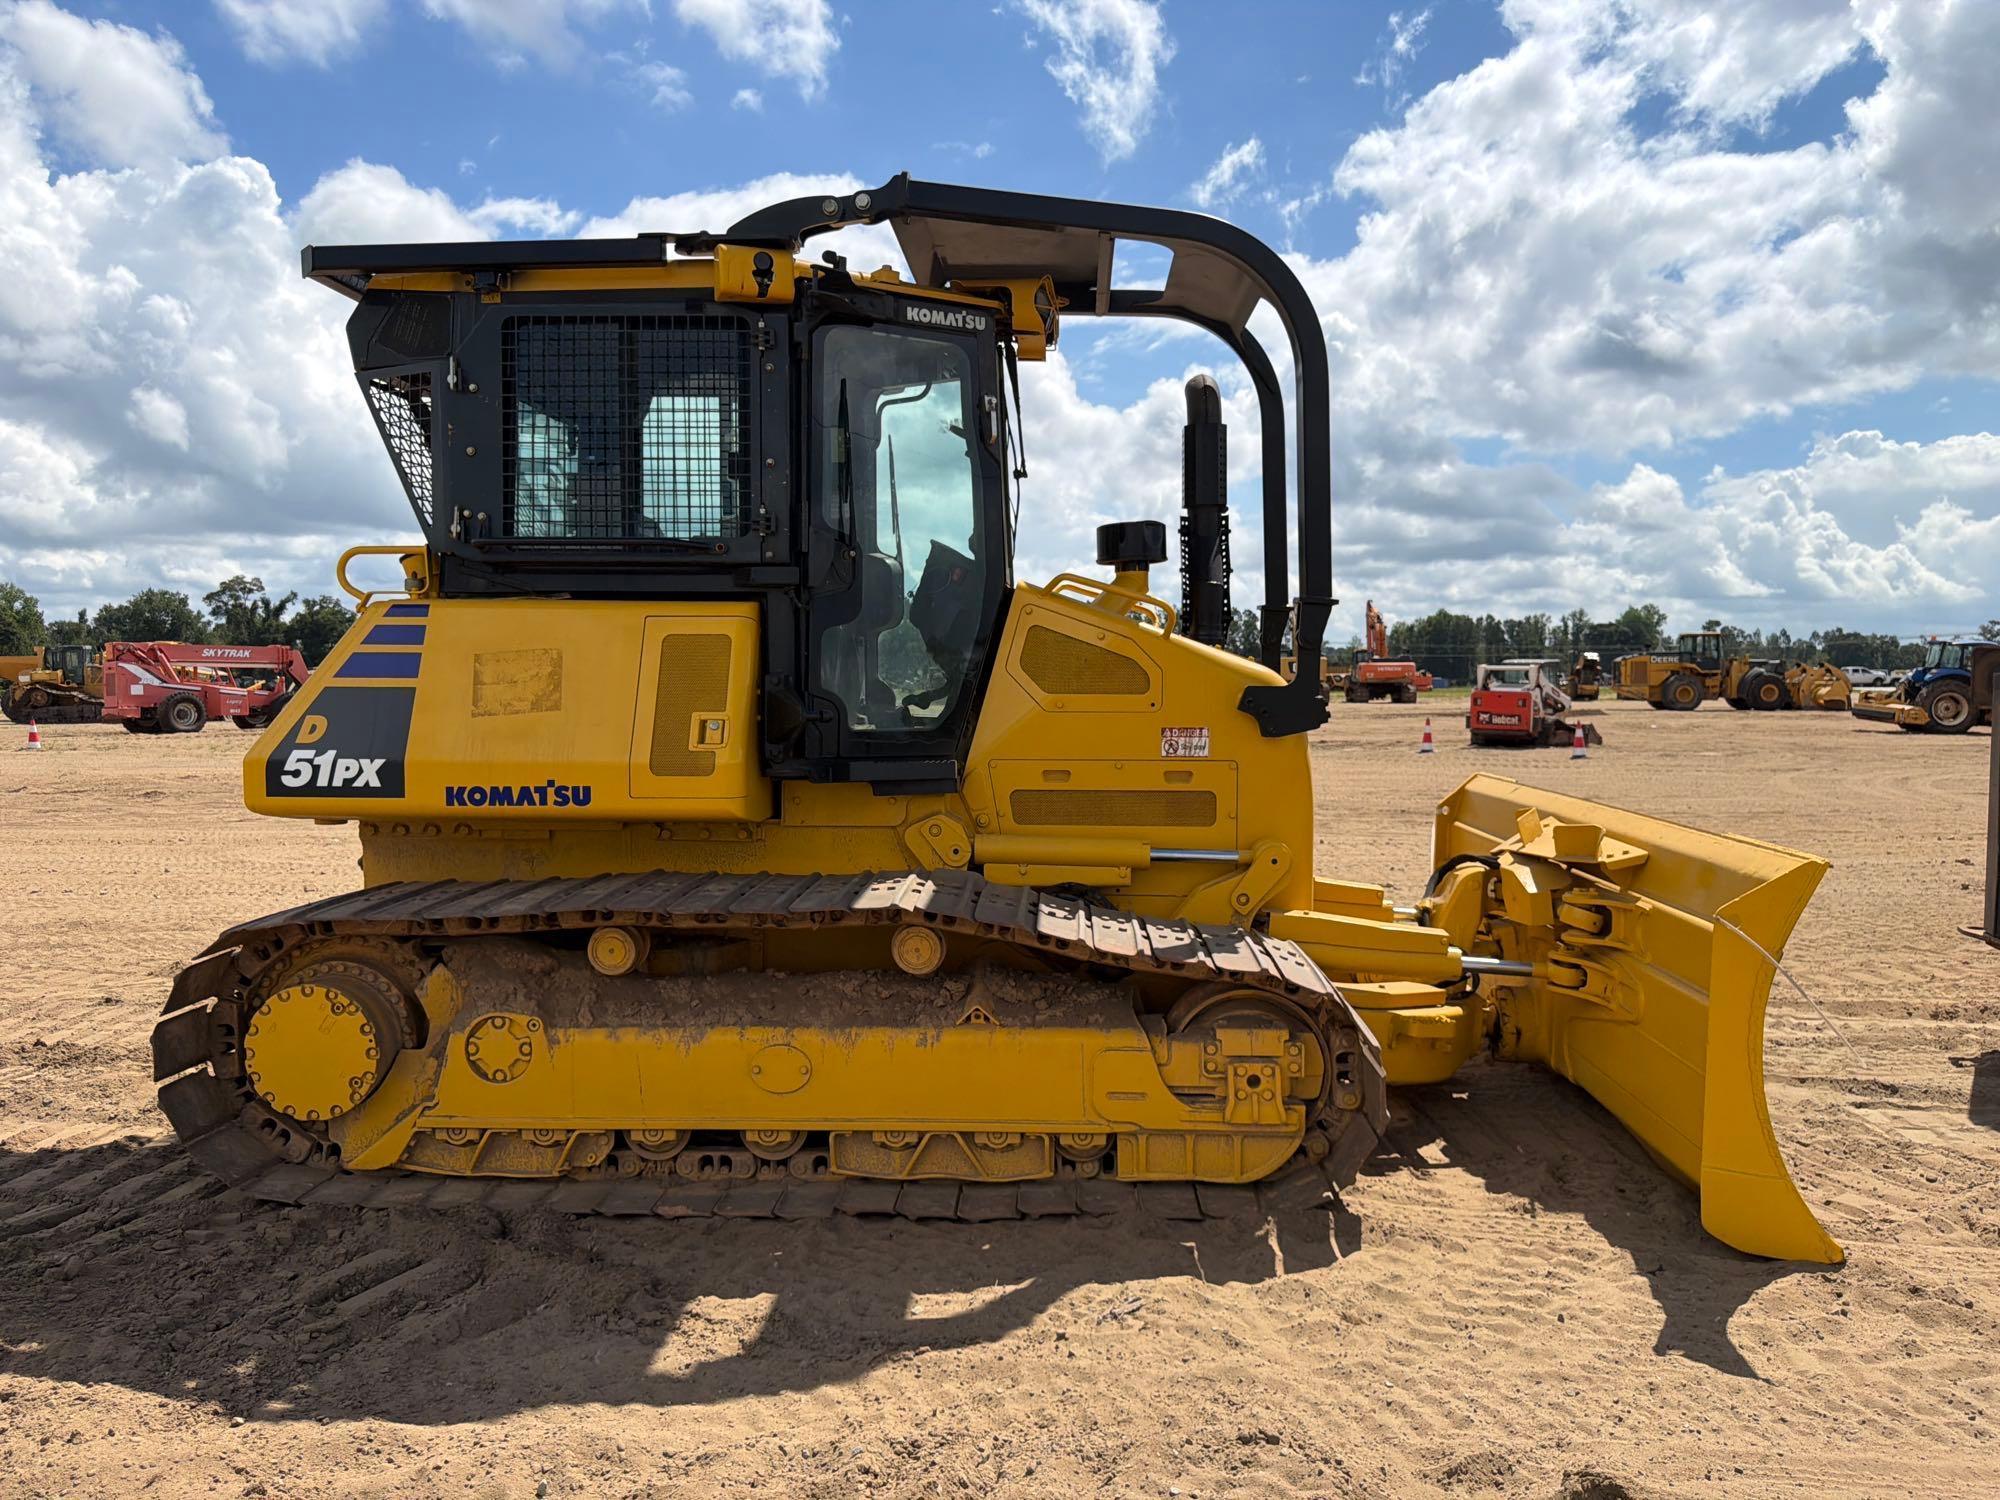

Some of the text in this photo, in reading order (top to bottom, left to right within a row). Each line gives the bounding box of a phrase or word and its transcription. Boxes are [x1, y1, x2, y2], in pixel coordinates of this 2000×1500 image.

[906, 306, 986, 331] KOMATSU
[201, 648, 251, 658] SKYTRAK
[1650, 655, 1680, 664] DEERE
[1491, 714, 1519, 725] Bobcat
[295, 715, 329, 744] D
[1172, 728, 1209, 737] DANGER
[280, 749, 386, 788] 51PX
[445, 779, 592, 807] KOMATSU
